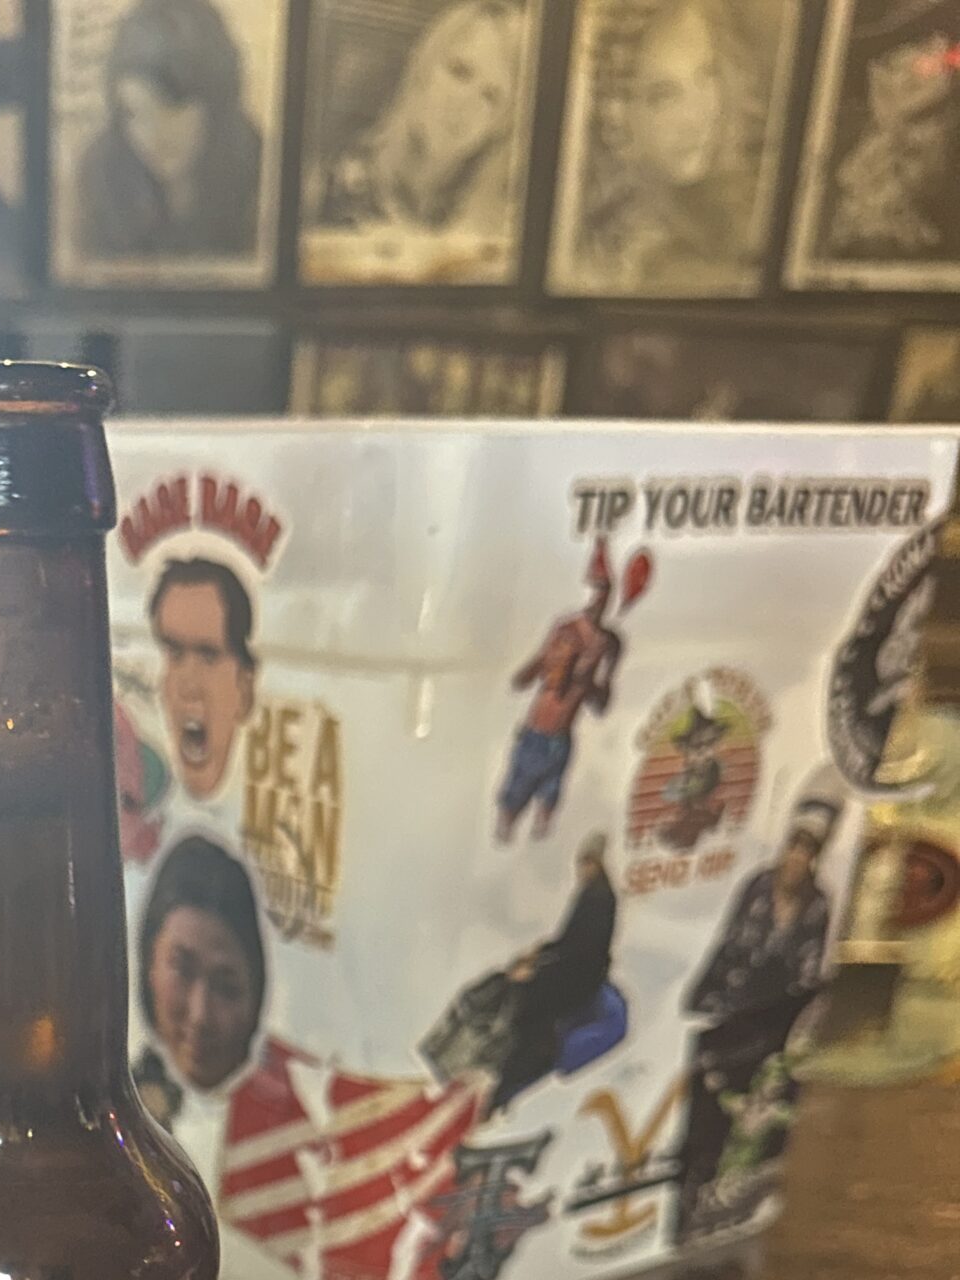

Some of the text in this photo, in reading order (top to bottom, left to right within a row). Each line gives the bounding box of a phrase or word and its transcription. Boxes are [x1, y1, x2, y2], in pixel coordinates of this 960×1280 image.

[573, 484, 928, 532] TIP YOUR BARTENDER
